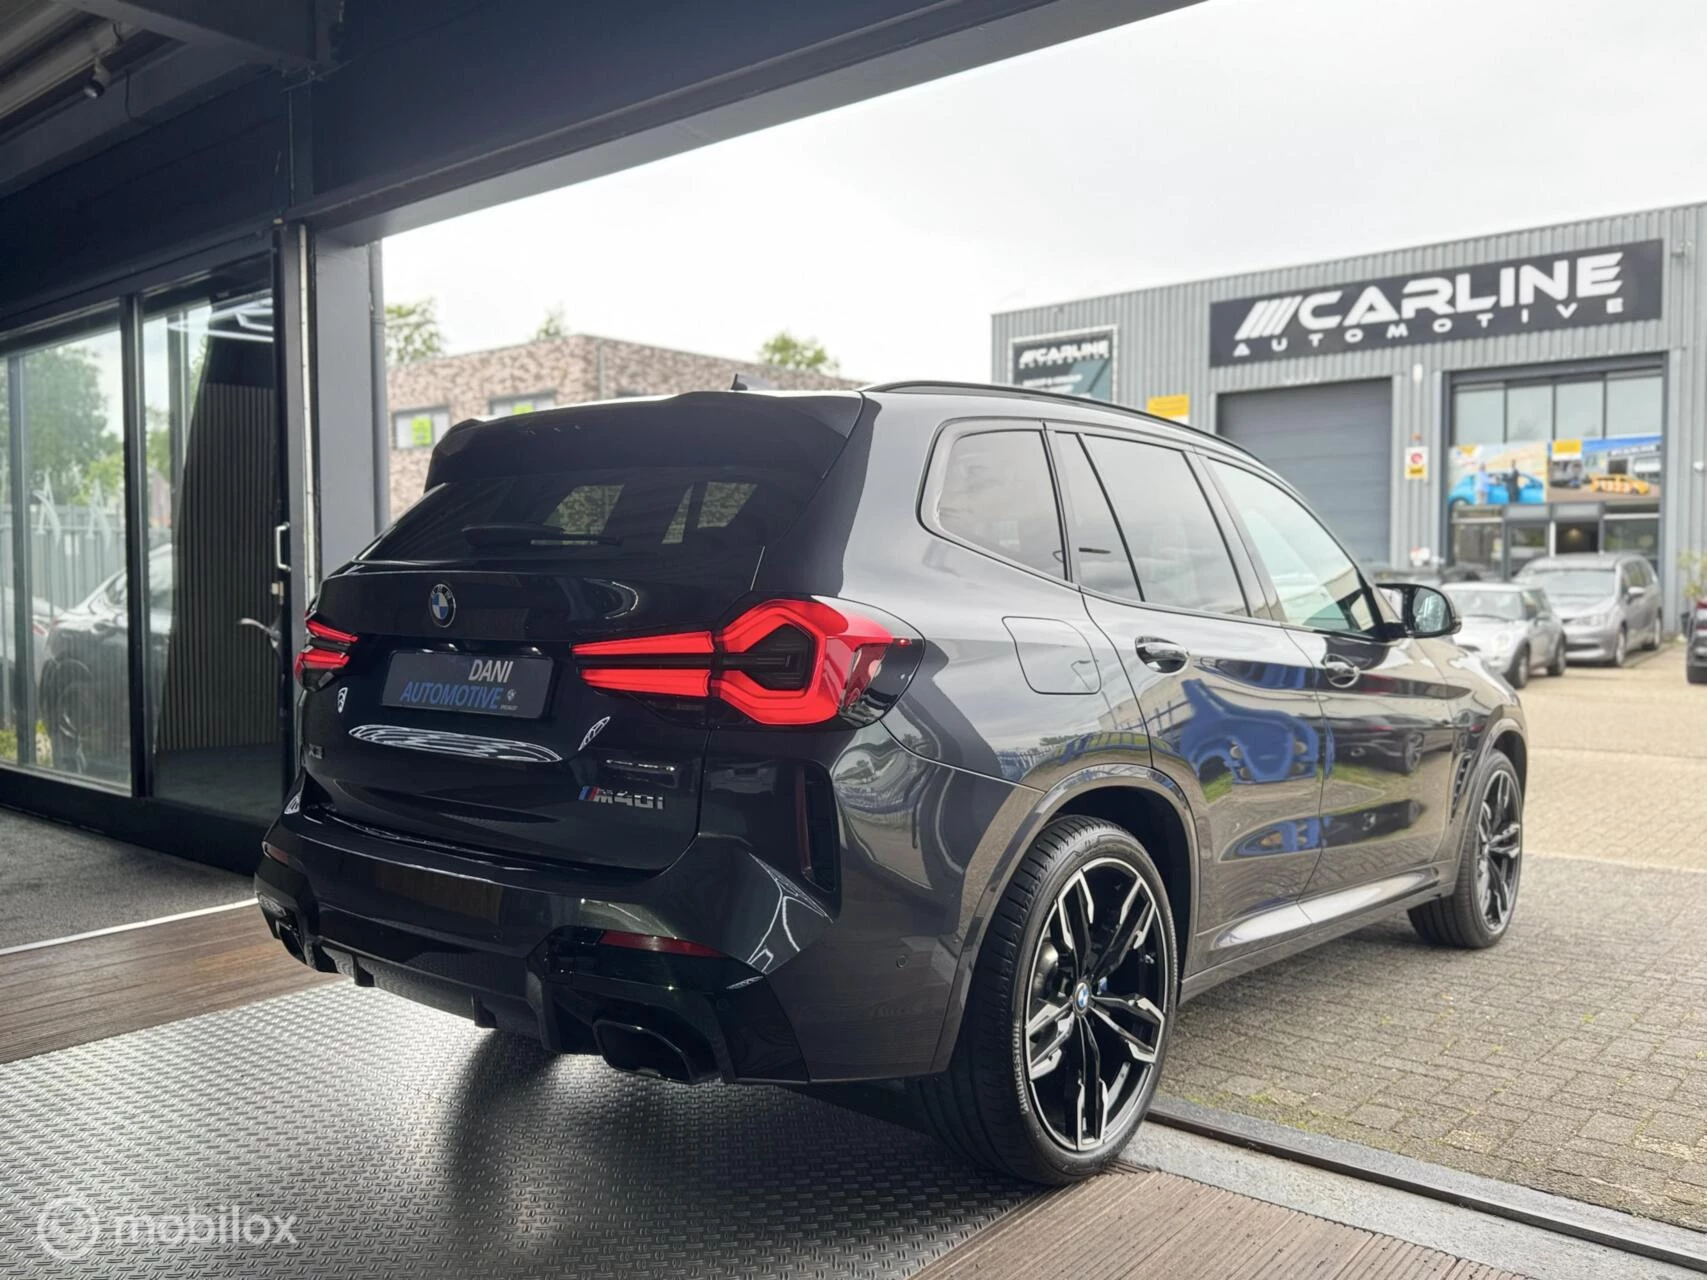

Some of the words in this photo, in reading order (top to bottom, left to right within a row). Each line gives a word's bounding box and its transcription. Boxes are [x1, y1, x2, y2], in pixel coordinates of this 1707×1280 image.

[1298, 251, 1625, 329] CARLINE
[1232, 297, 1625, 358] AUTOMOTIVE
[468, 659, 514, 684] DANI
[400, 681, 504, 710] AUTOMOTIVE
